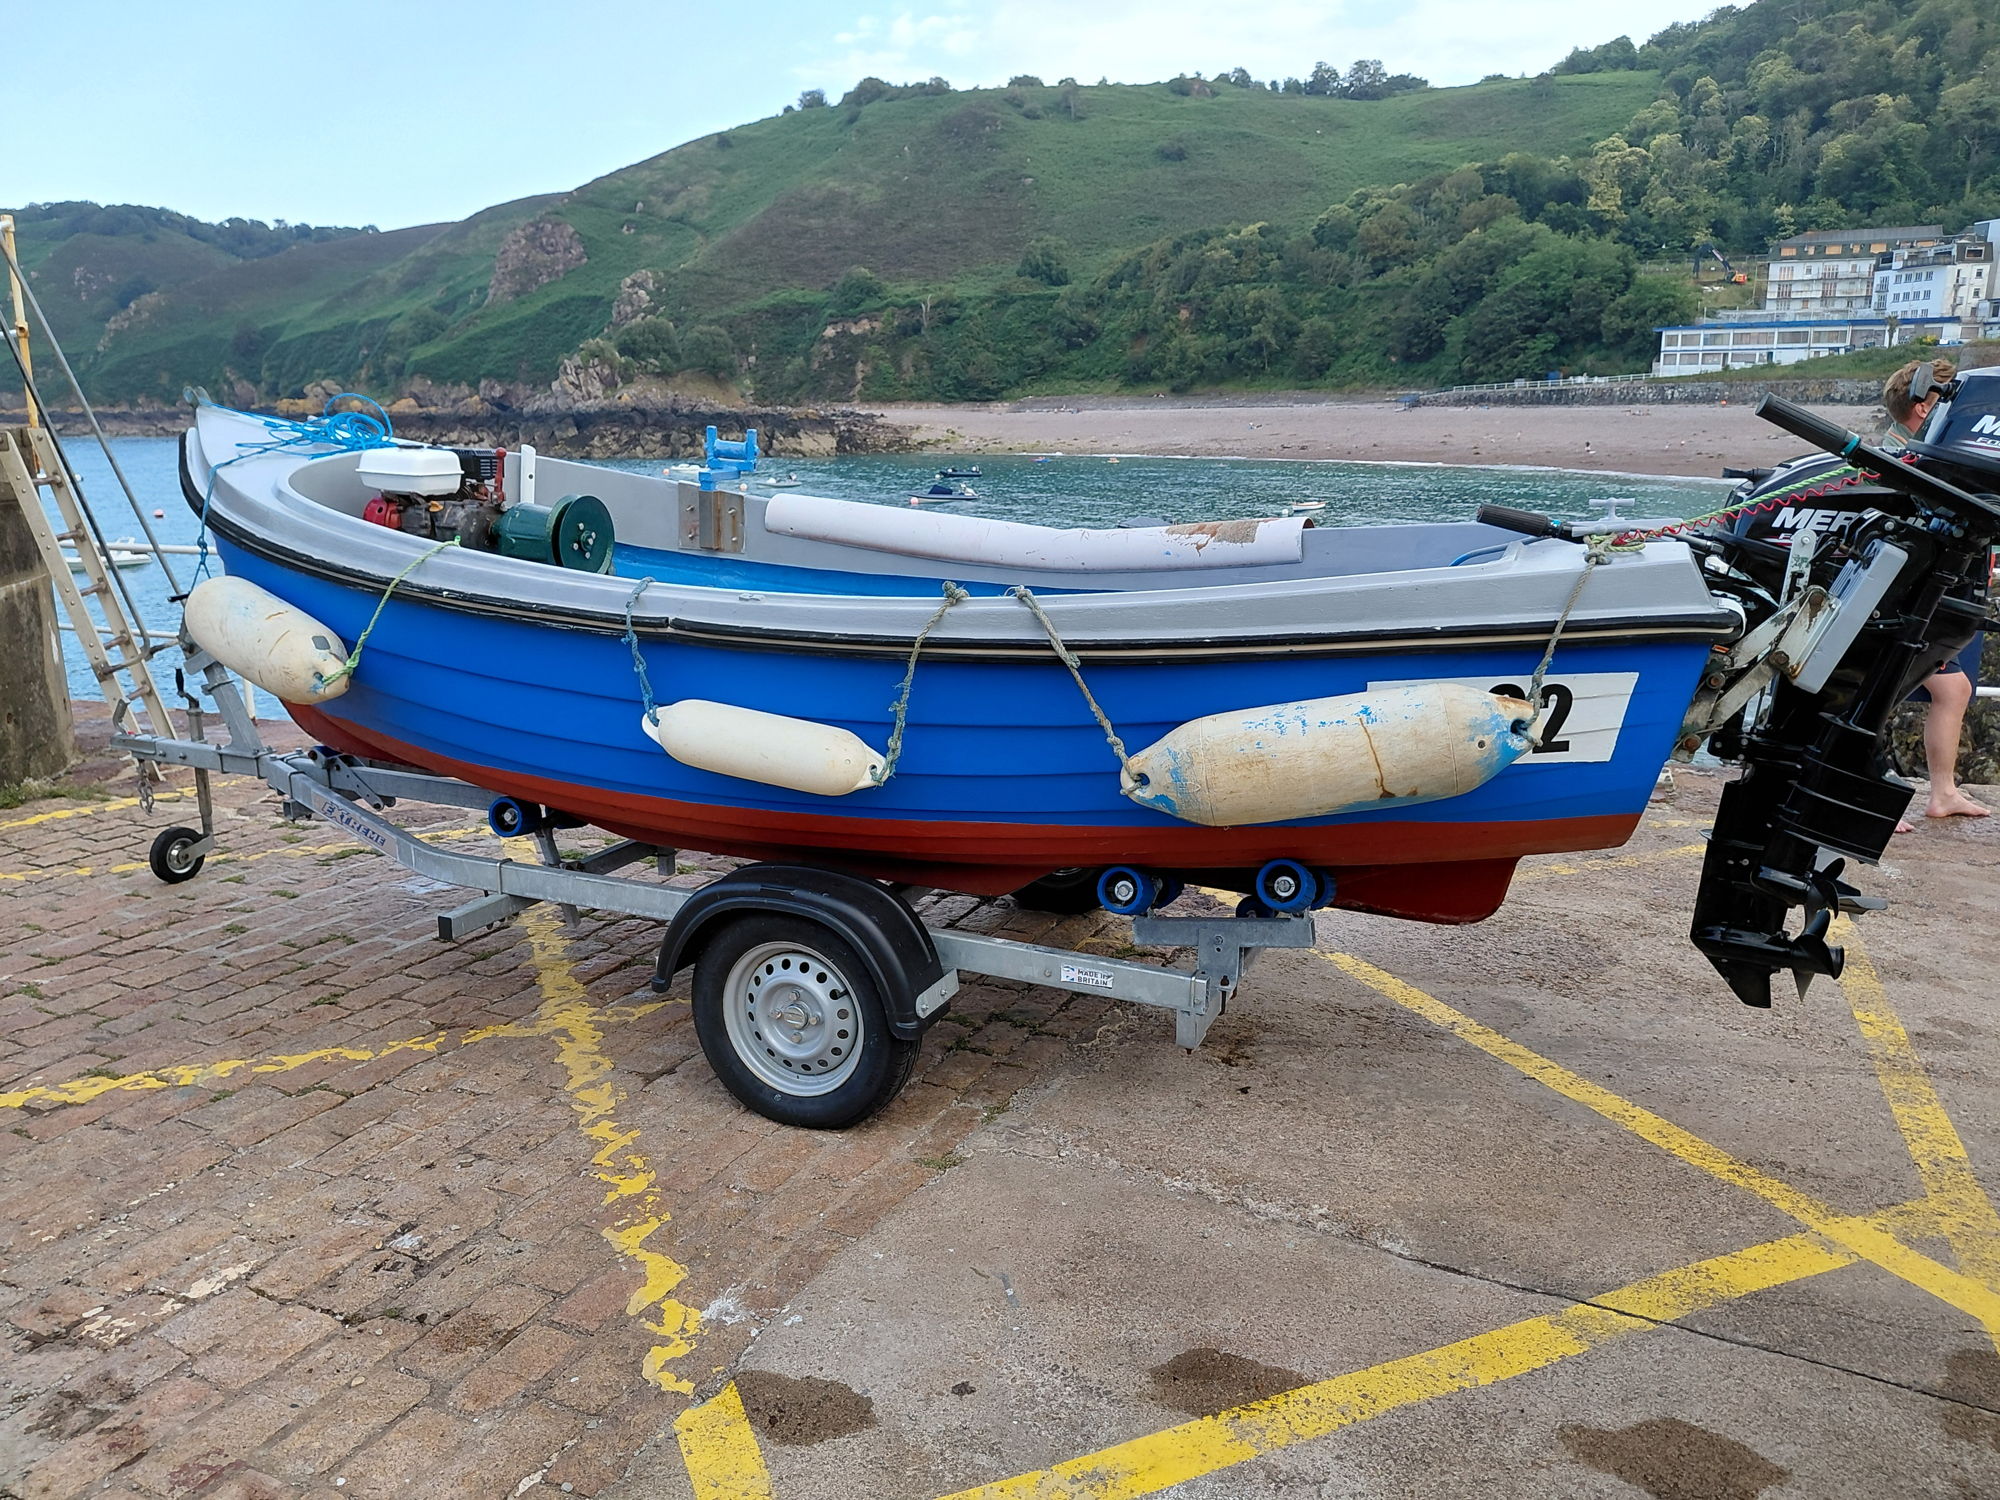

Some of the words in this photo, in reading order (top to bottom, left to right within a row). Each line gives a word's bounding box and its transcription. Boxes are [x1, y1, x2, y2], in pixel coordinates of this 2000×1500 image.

[1489, 683, 1573, 754] 2
[321, 801, 386, 846] EXTREME
[1077, 968, 1099, 979] MADE
[1077, 975, 1108, 986] BRITAIN
